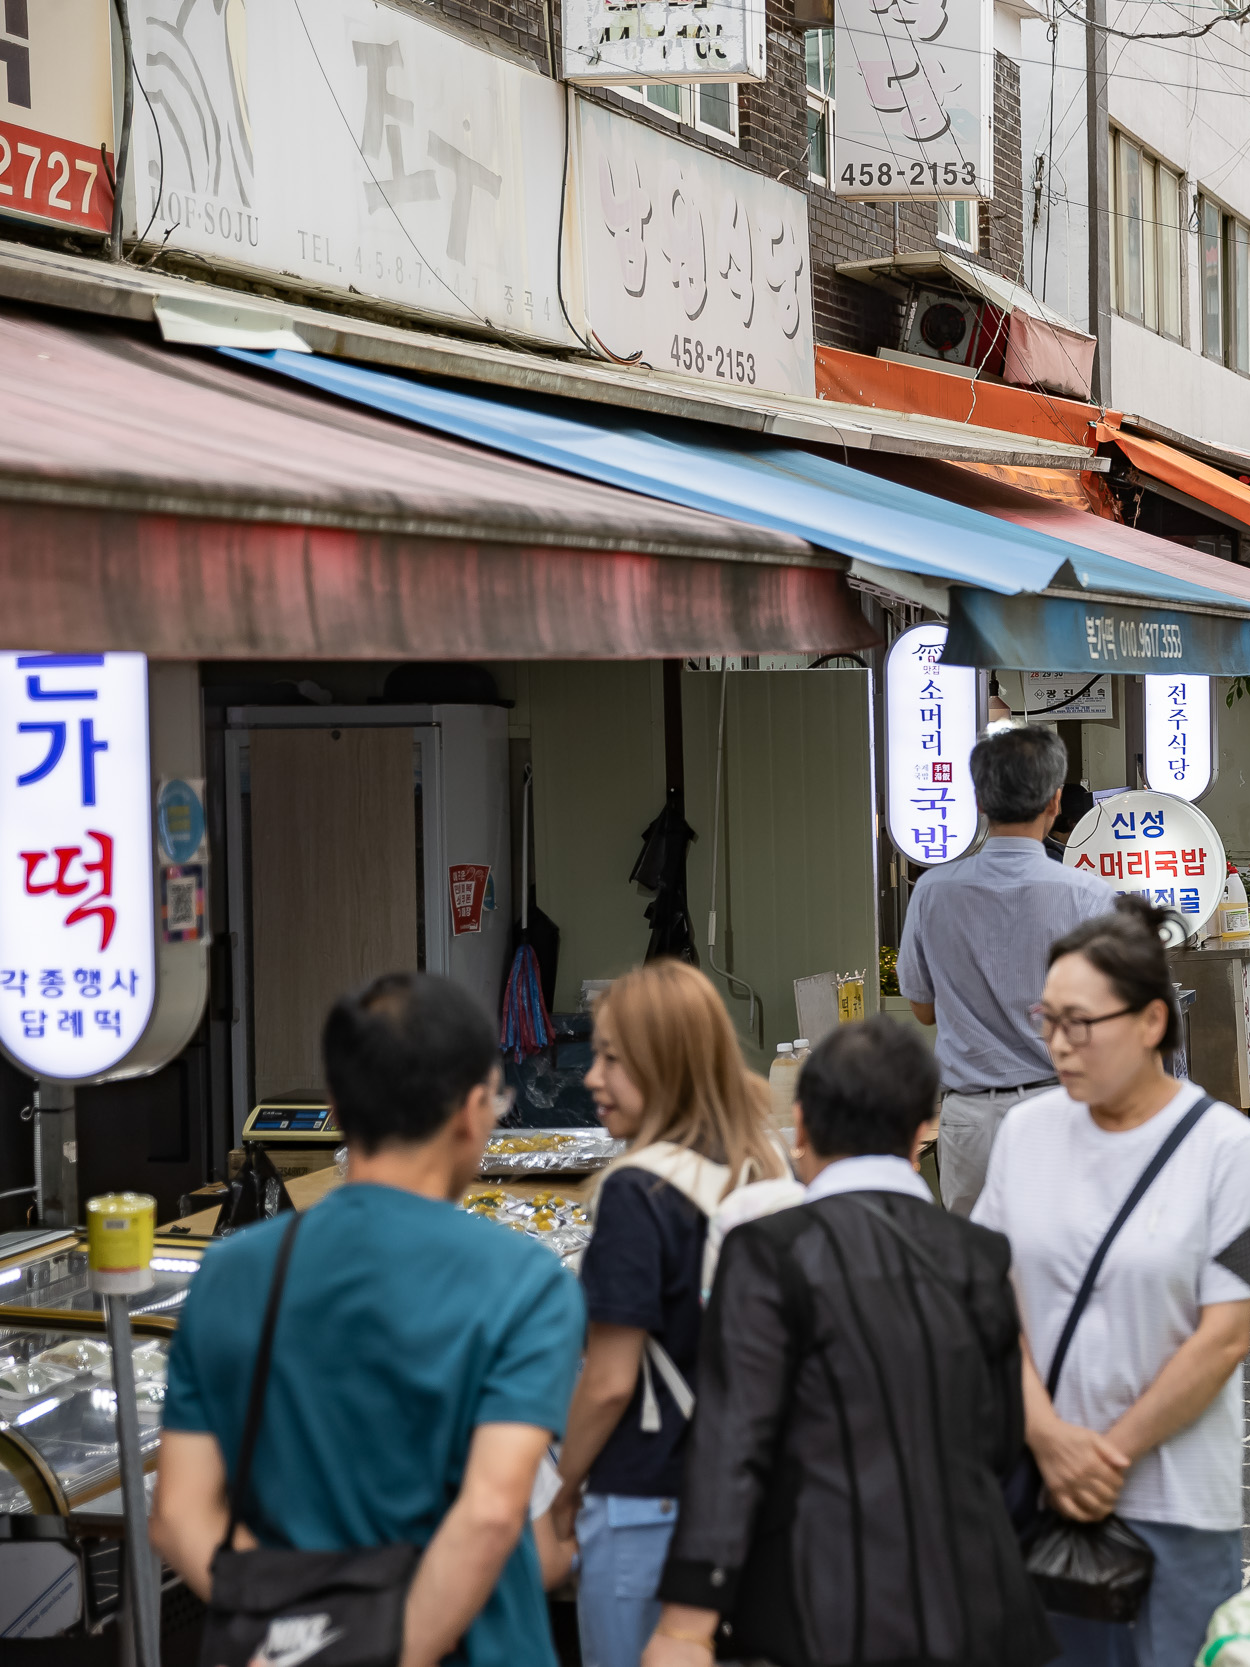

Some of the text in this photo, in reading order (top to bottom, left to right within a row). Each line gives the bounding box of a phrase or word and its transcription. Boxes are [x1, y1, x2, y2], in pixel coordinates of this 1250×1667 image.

[841, 161, 976, 187] 458-2153
[297, 229, 343, 272] TEL.
[670, 334, 756, 385] 458-2153
[923, 665, 941, 676] 맛집
[919, 679, 944, 757] 소머리
[1167, 682, 1190, 781] 전주식당
[910, 786, 957, 860] 국밥
[1111, 810, 1165, 840] 신성
[1074, 848, 1207, 879] 소머리국밥
[20, 830, 116, 952] 떡
[0, 968, 138, 999] 각종행사
[20, 1008, 122, 1038] 답례떡
